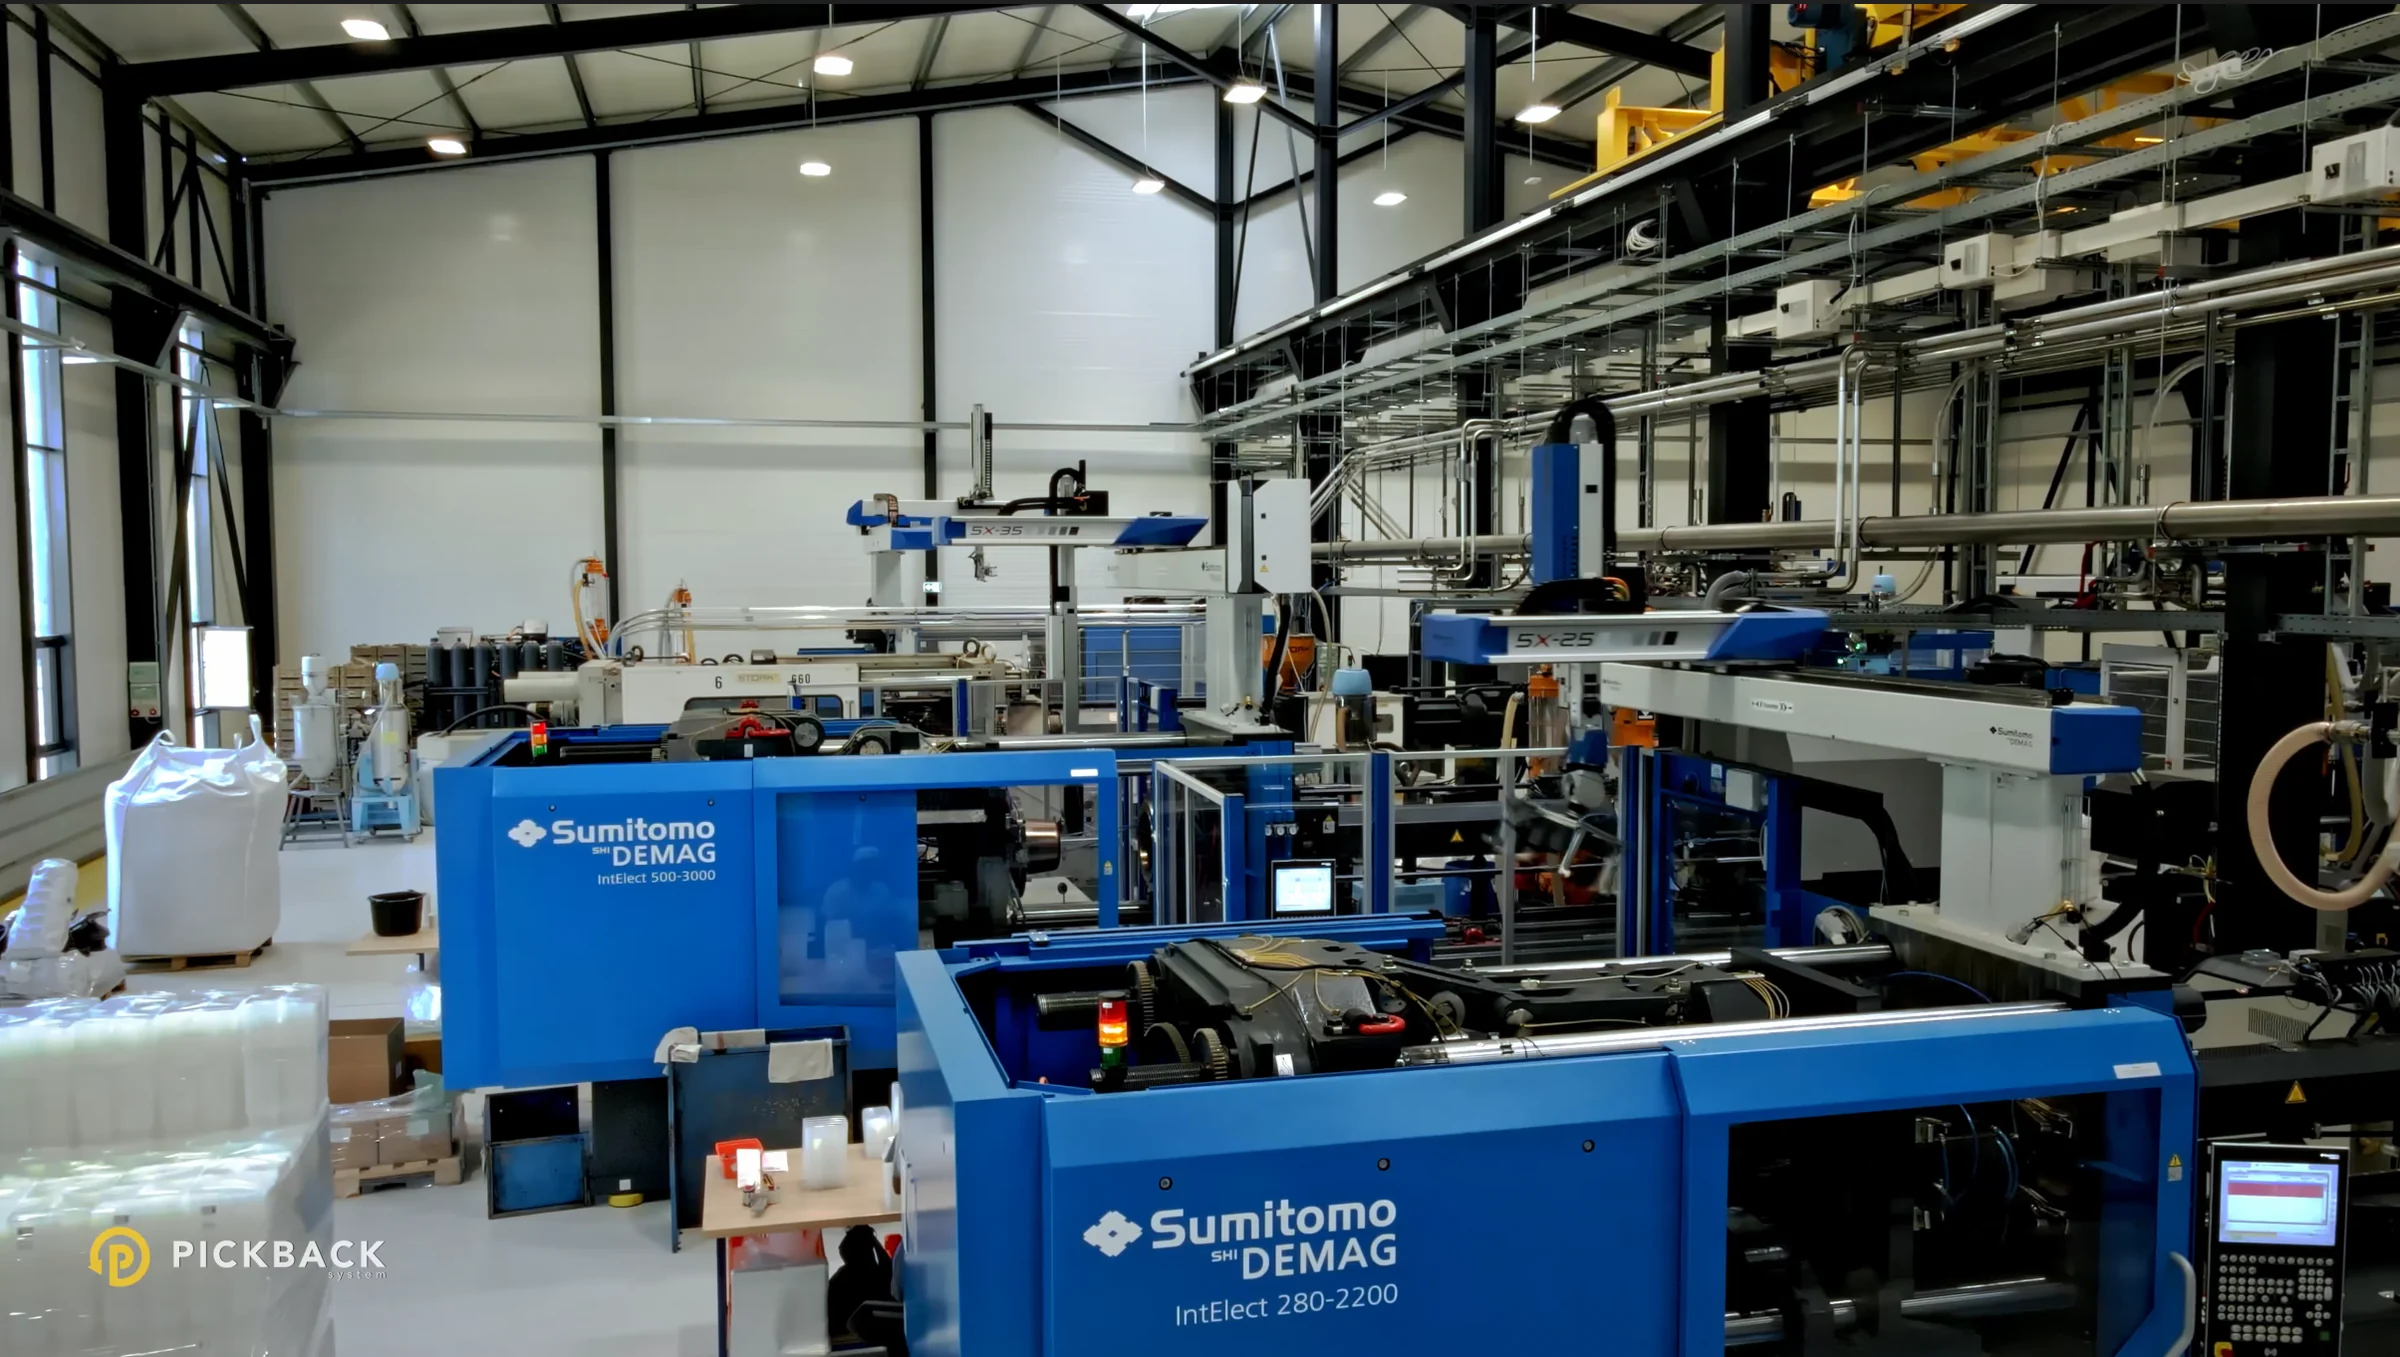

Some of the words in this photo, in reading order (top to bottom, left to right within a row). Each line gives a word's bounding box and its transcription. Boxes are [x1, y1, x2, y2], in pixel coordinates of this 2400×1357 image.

[971, 525, 1023, 536] SX-35
[1515, 632, 1595, 648] SX-25
[715, 675, 723, 689] 6
[551, 818, 715, 844] Sumitomo
[592, 847, 610, 855] SHI
[612, 842, 716, 867] DEMAG
[597, 872, 647, 885] IntElect
[651, 870, 716, 883] 500-3000
[1150, 1199, 1397, 1249] Sumitomo
[1211, 1249, 1238, 1262] SHI
[1242, 1234, 1397, 1280] DEMAG
[1176, 1298, 1268, 1326] IntElect
[1277, 1283, 1398, 1316] 280-2200
